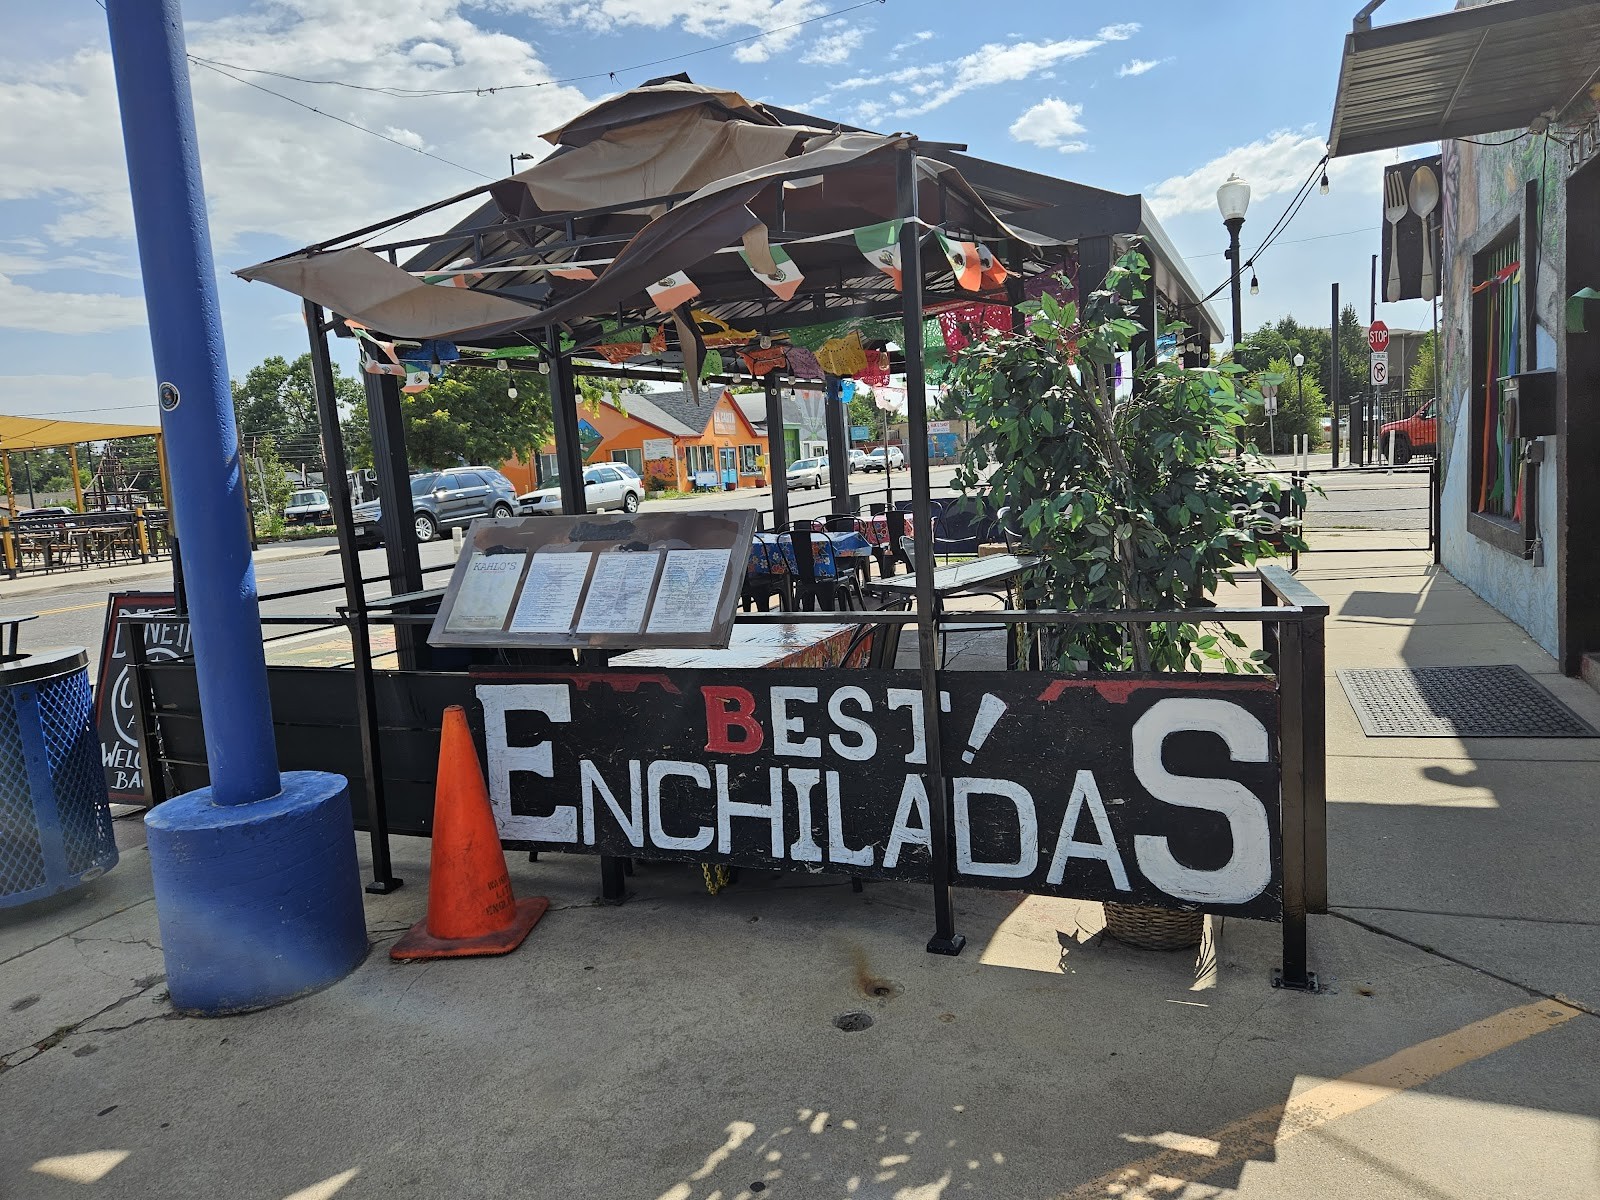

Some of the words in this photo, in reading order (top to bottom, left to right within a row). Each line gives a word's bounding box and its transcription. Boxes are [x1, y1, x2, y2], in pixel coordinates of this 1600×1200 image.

[1369, 330, 1388, 343] STOP
[473, 562, 517, 571] KAHLO'S
[475, 684, 1271, 904] ENCHILADAS
